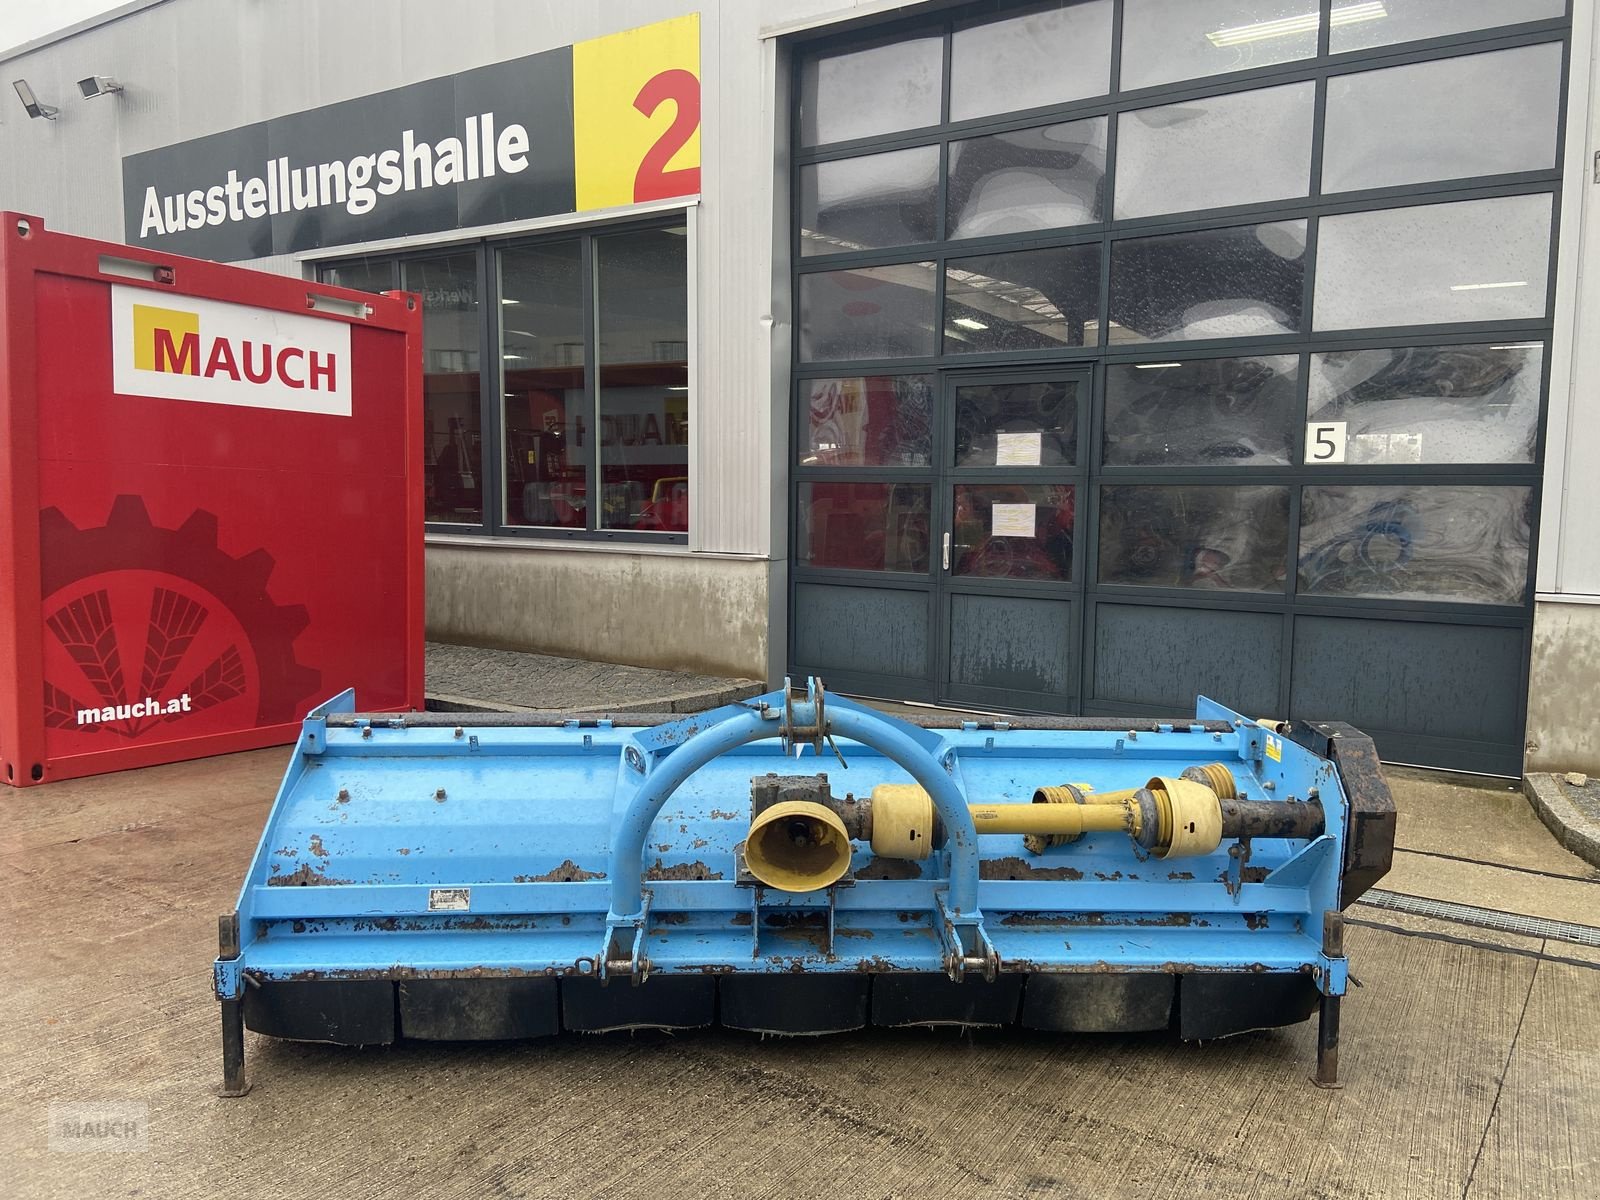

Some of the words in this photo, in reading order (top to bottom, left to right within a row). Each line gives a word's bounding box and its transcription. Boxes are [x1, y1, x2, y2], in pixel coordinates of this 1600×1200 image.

[139, 112, 530, 239] Ausstellungshalle
[632, 68, 701, 204] 2
[153, 327, 337, 393] MAUCH
[1313, 427, 1336, 460] 5
[77, 693, 192, 725] mauch.at
